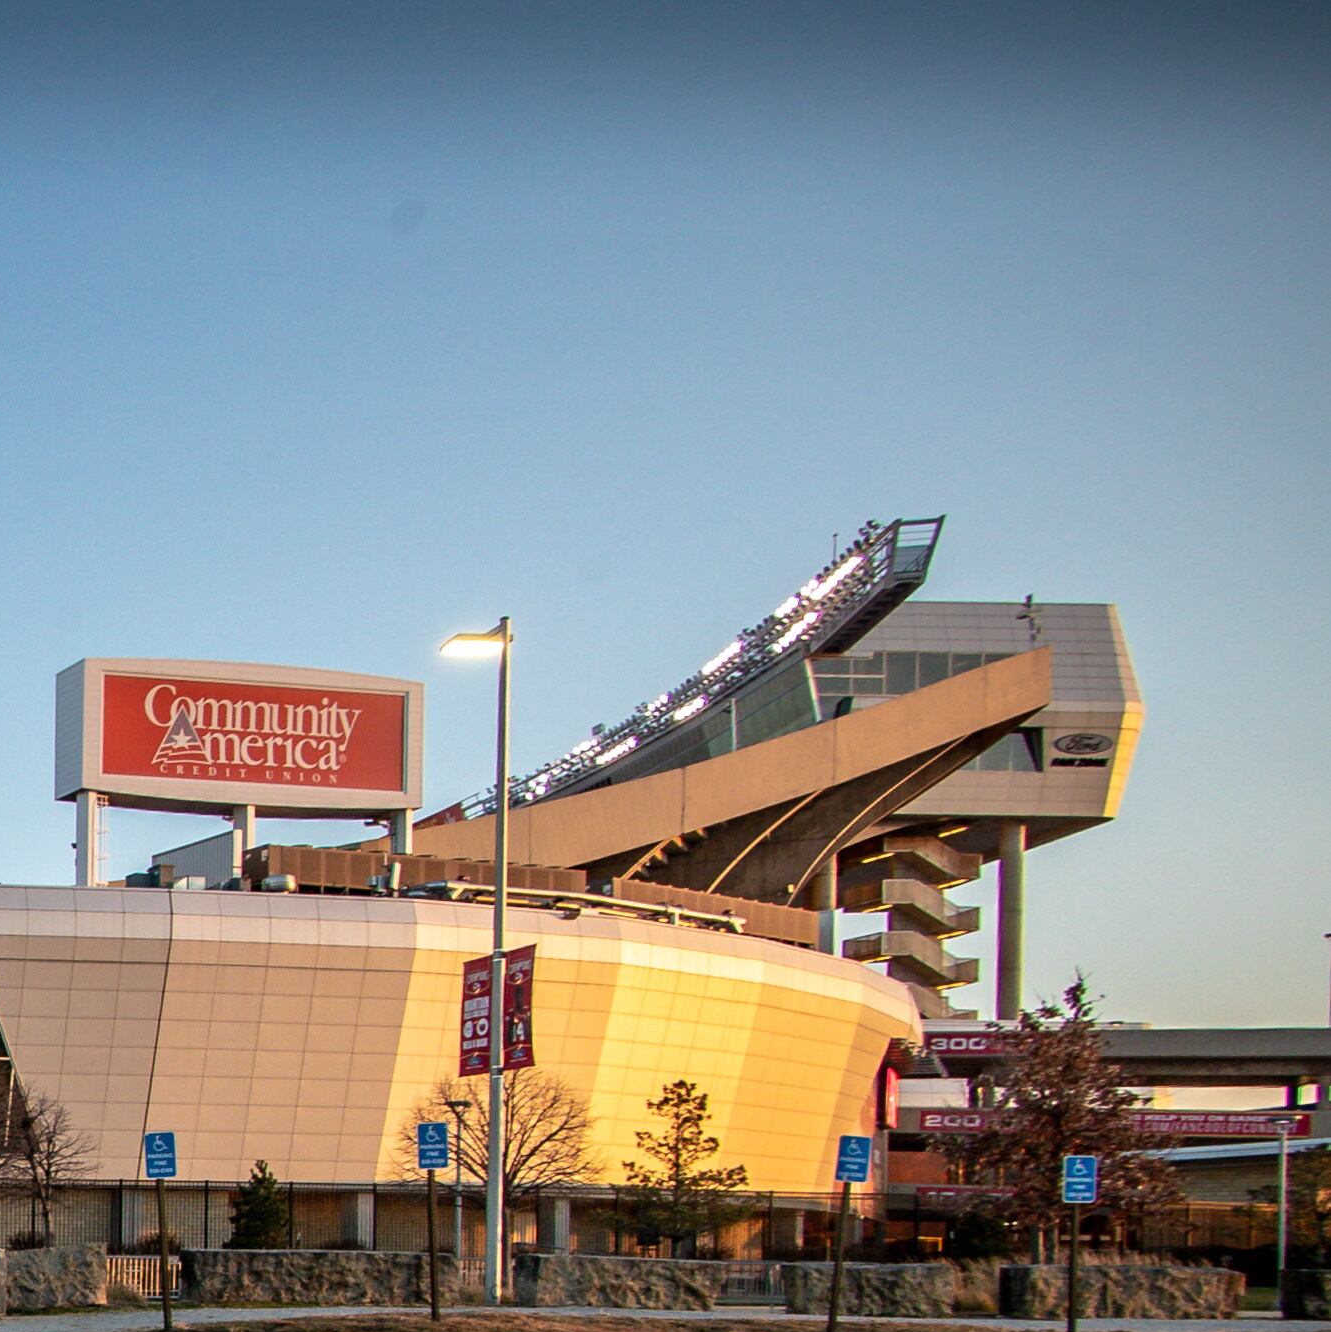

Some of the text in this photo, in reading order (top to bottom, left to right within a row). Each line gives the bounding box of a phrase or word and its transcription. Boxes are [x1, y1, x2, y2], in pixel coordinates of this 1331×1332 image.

[144, 684, 362, 751] Community
[159, 763, 338, 784] CREDIT UNION
[930, 1038, 987, 1050] 300
[924, 1115, 982, 1127] 200
